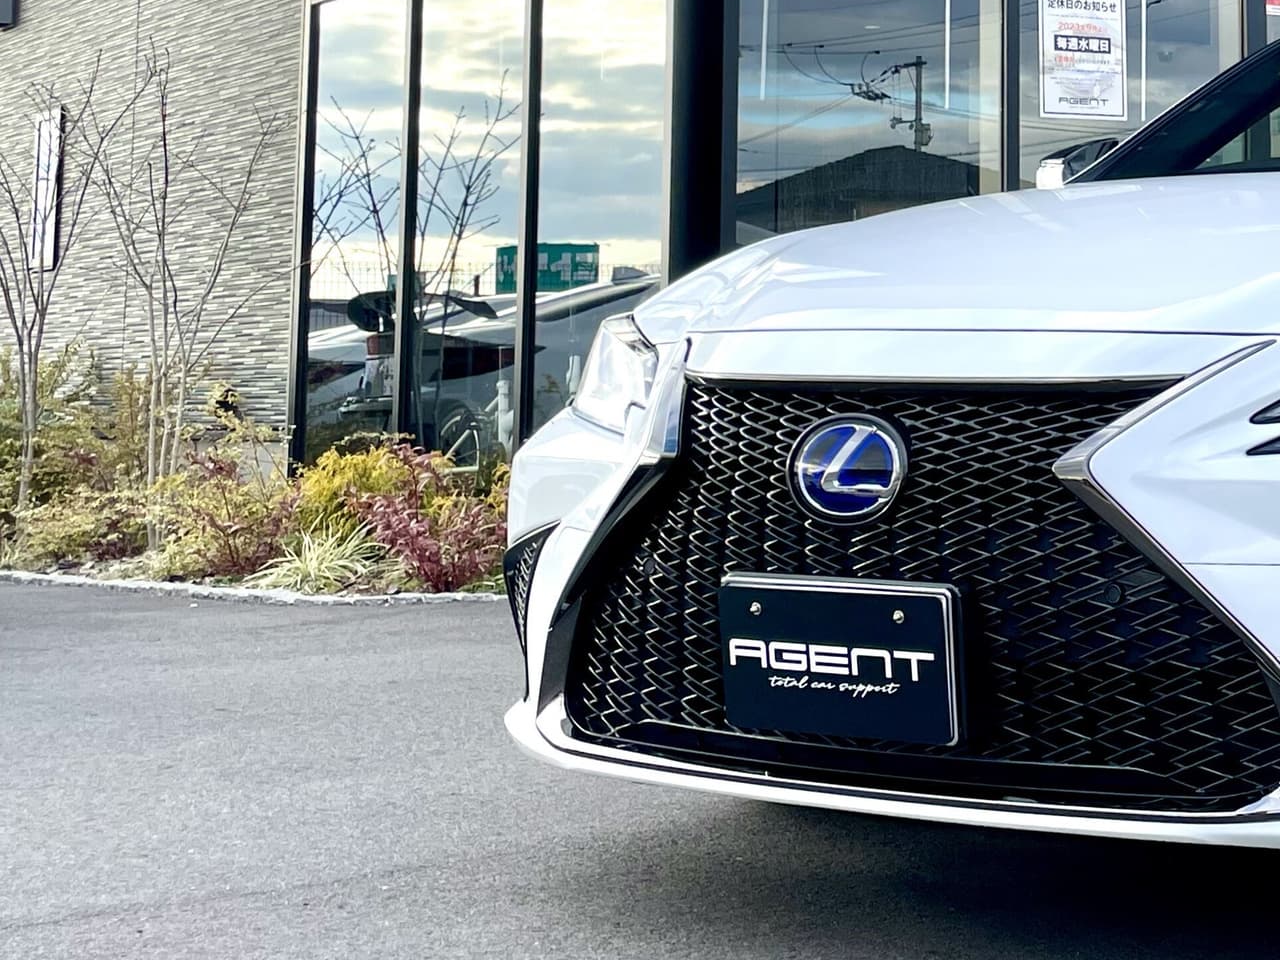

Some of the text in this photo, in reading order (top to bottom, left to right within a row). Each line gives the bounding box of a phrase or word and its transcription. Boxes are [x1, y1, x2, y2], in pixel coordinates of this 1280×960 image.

[1056, 36, 1109, 52] 毎週水曜日
[1058, 96, 1110, 107] AGENT
[728, 638, 935, 682] AGENT
[767, 675, 901, 699] total car support
